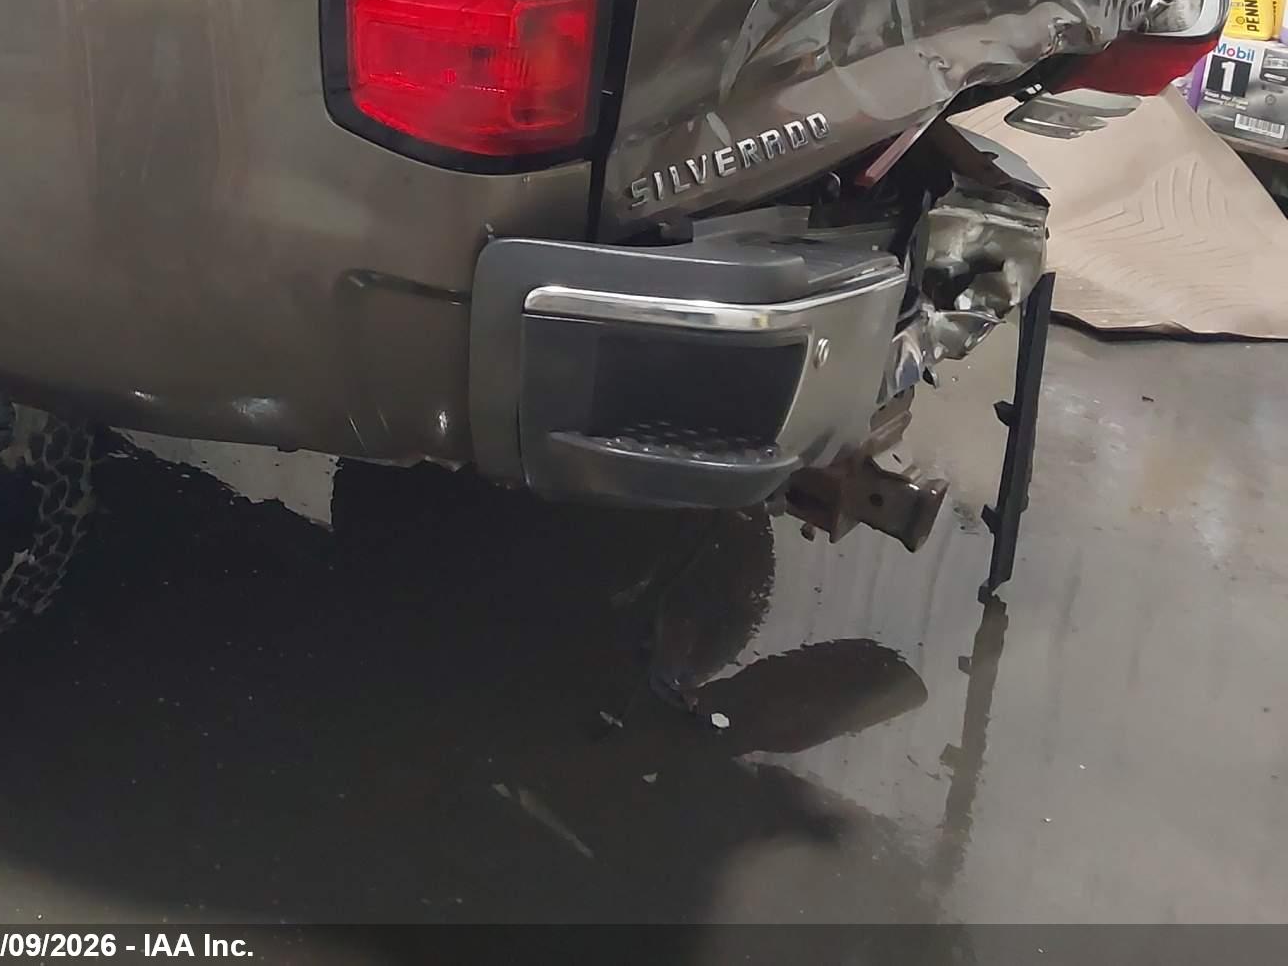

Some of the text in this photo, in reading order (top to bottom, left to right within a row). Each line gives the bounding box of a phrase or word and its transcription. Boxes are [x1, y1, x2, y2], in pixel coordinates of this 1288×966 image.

[1214, 43, 1255, 61] Mobil
[1221, 61, 1236, 93] 1
[631, 112, 830, 208] SILVERADO
